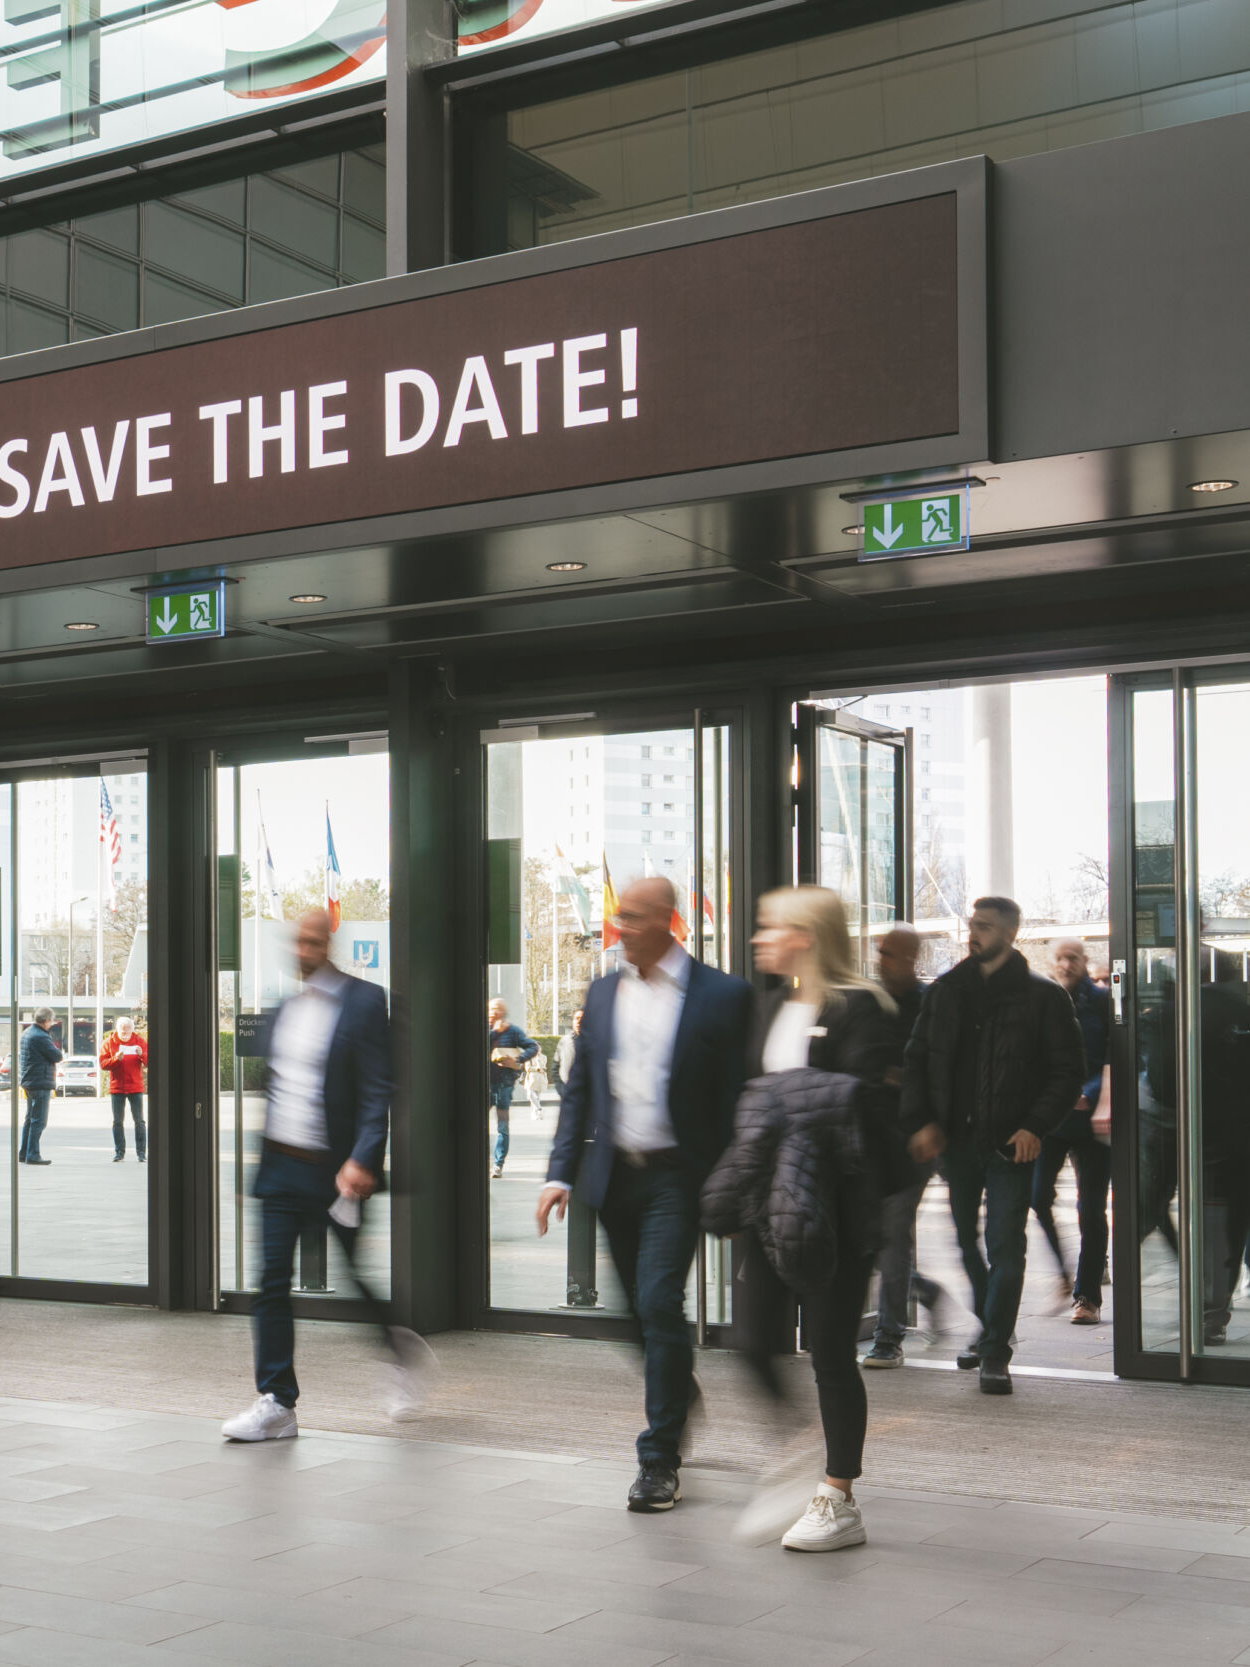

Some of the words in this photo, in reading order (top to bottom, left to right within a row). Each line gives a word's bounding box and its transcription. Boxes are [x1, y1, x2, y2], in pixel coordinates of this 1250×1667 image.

[199, 381, 348, 484] THE
[385, 328, 637, 456] DATE!
[238, 1029, 255, 1037] Push
